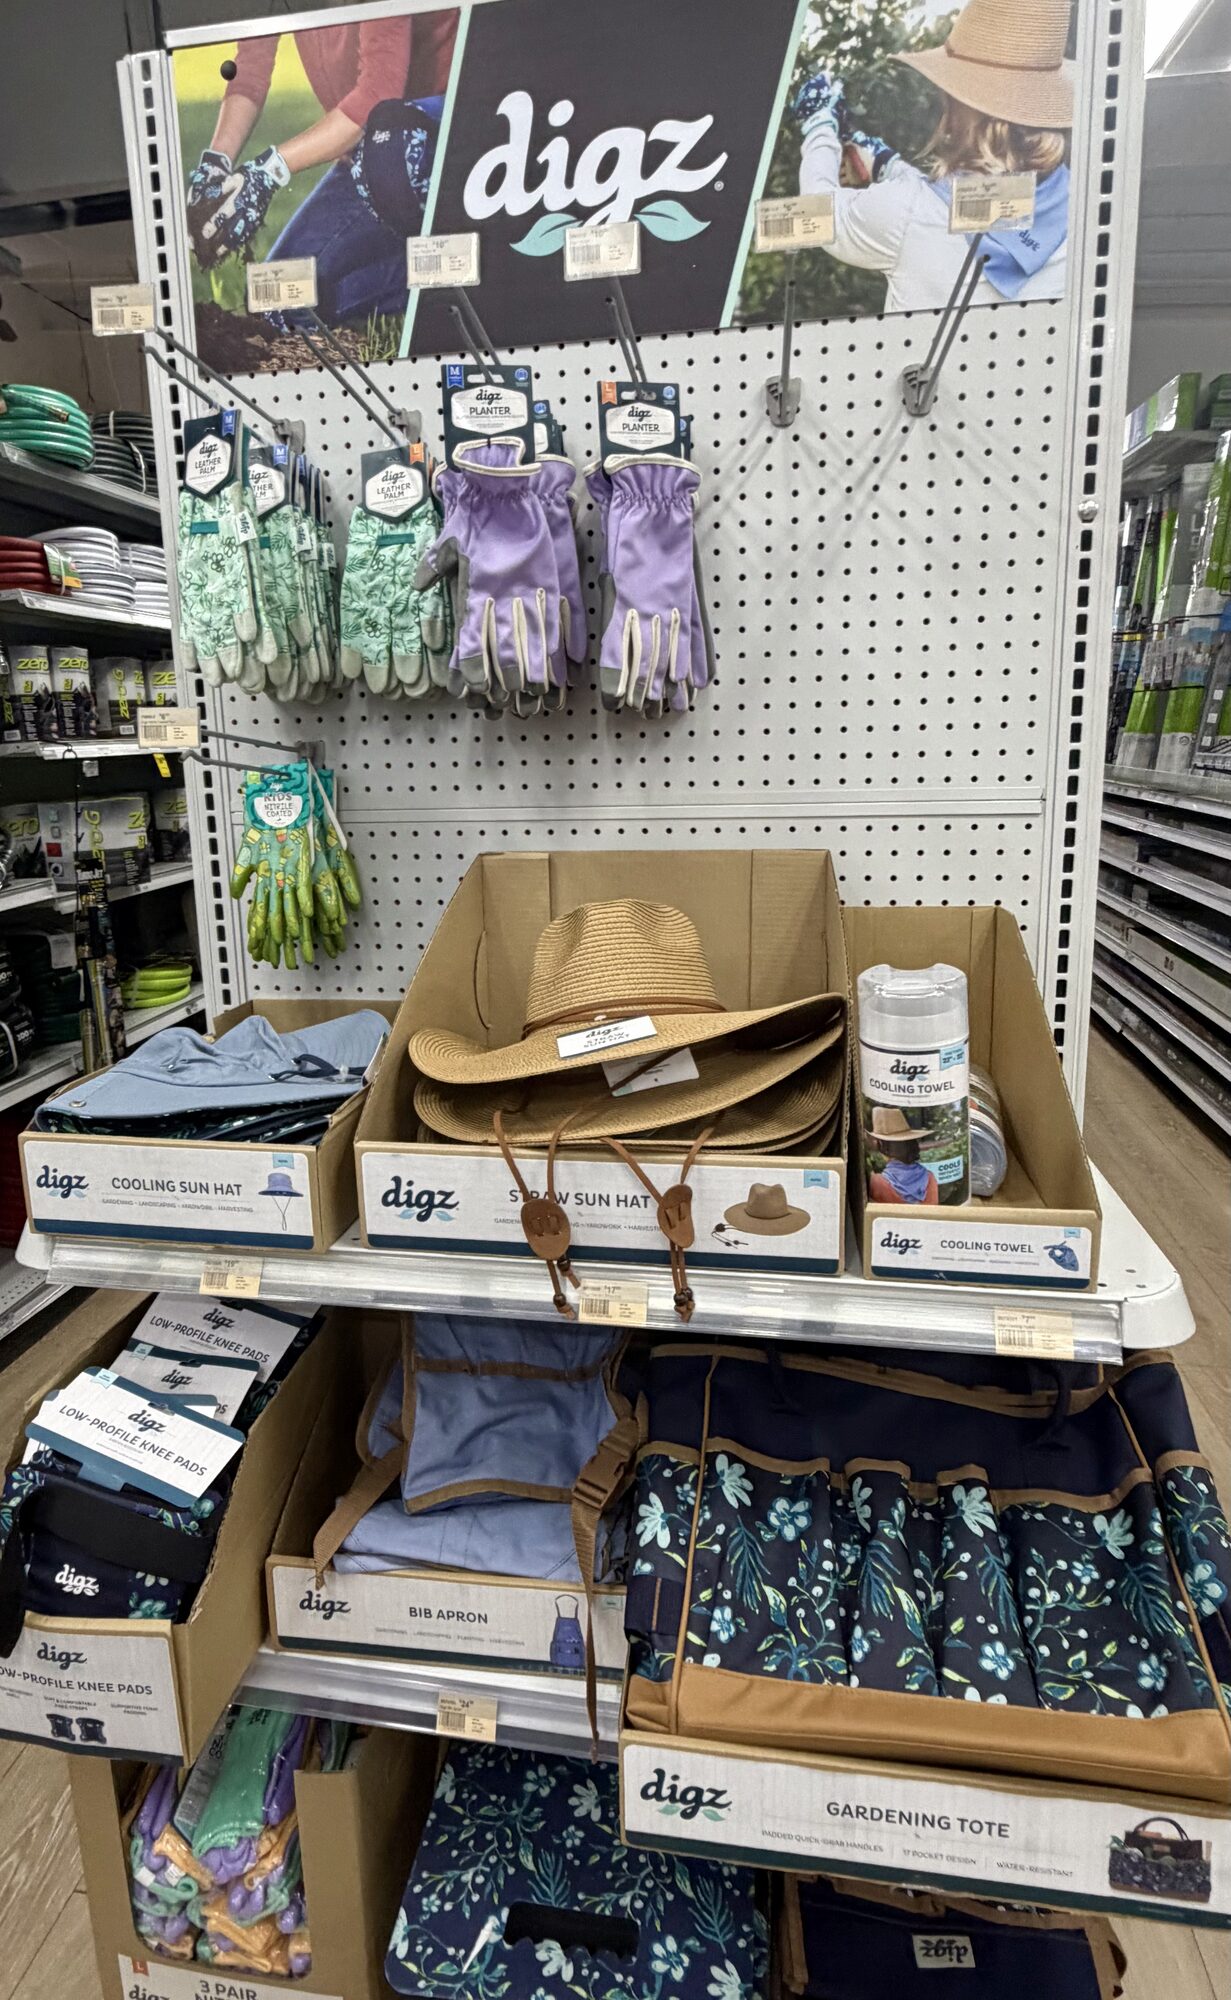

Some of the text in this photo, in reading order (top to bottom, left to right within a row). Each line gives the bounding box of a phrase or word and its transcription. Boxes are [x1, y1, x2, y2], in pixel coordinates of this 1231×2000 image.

[463, 90, 729, 227] digz
[476, 389, 503, 405] digz
[469, 406, 512, 416] PLANTER
[628, 406, 653, 422] digz
[622, 423, 660, 432] PLANTER
[200, 442, 218, 458] digz
[195, 456, 222, 469] LEATHER
[381, 471, 406, 484] digz
[377, 482, 411, 494] LEATHER
[384, 490, 405, 499] PALM
[263, 791, 292, 802] KIDS
[889, 1058, 930, 1082] digz
[869, 1078, 955, 1094] COOLING TOWEL
[938, 1160, 961, 1171] COOLS
[36, 1165, 89, 1199] digz
[111, 1177, 242, 1196] COOLING SUN HAT
[381, 1175, 460, 1223] digz
[574, 1192, 610, 1208] SUN
[616, 1194, 651, 1209] HAT
[880, 1231, 923, 1256] digz
[940, 1239, 1035, 1254] COOLING TOWEL
[203, 1308, 236, 1330] digz
[150, 1315, 270, 1363] LOW-PROFILE KNEE PADS
[161, 1370, 193, 1390] digz
[128, 1409, 168, 1433] digz
[59, 1404, 140, 1447] LOW-PROFILE
[139, 1439, 175, 1461] KNEE
[174, 1455, 208, 1477] PADS
[55, 1564, 99, 1595] digz
[299, 1590, 351, 1620] digz
[409, 1606, 489, 1625] BIB APRON
[37, 1642, 87, 1671] digz
[77, 1681, 115, 1693] KNEE
[118, 1683, 153, 1696] PADS
[640, 1768, 732, 1820] digz
[826, 1801, 1010, 1839] GARDENING TOTE
[846, 1841, 884, 1853] HANDLES
[919, 1938, 969, 1964] digz
[136, 1961, 145, 1971] L
[200, 1979, 210, 1993] 3
[215, 1983, 258, 2000] PAIR
